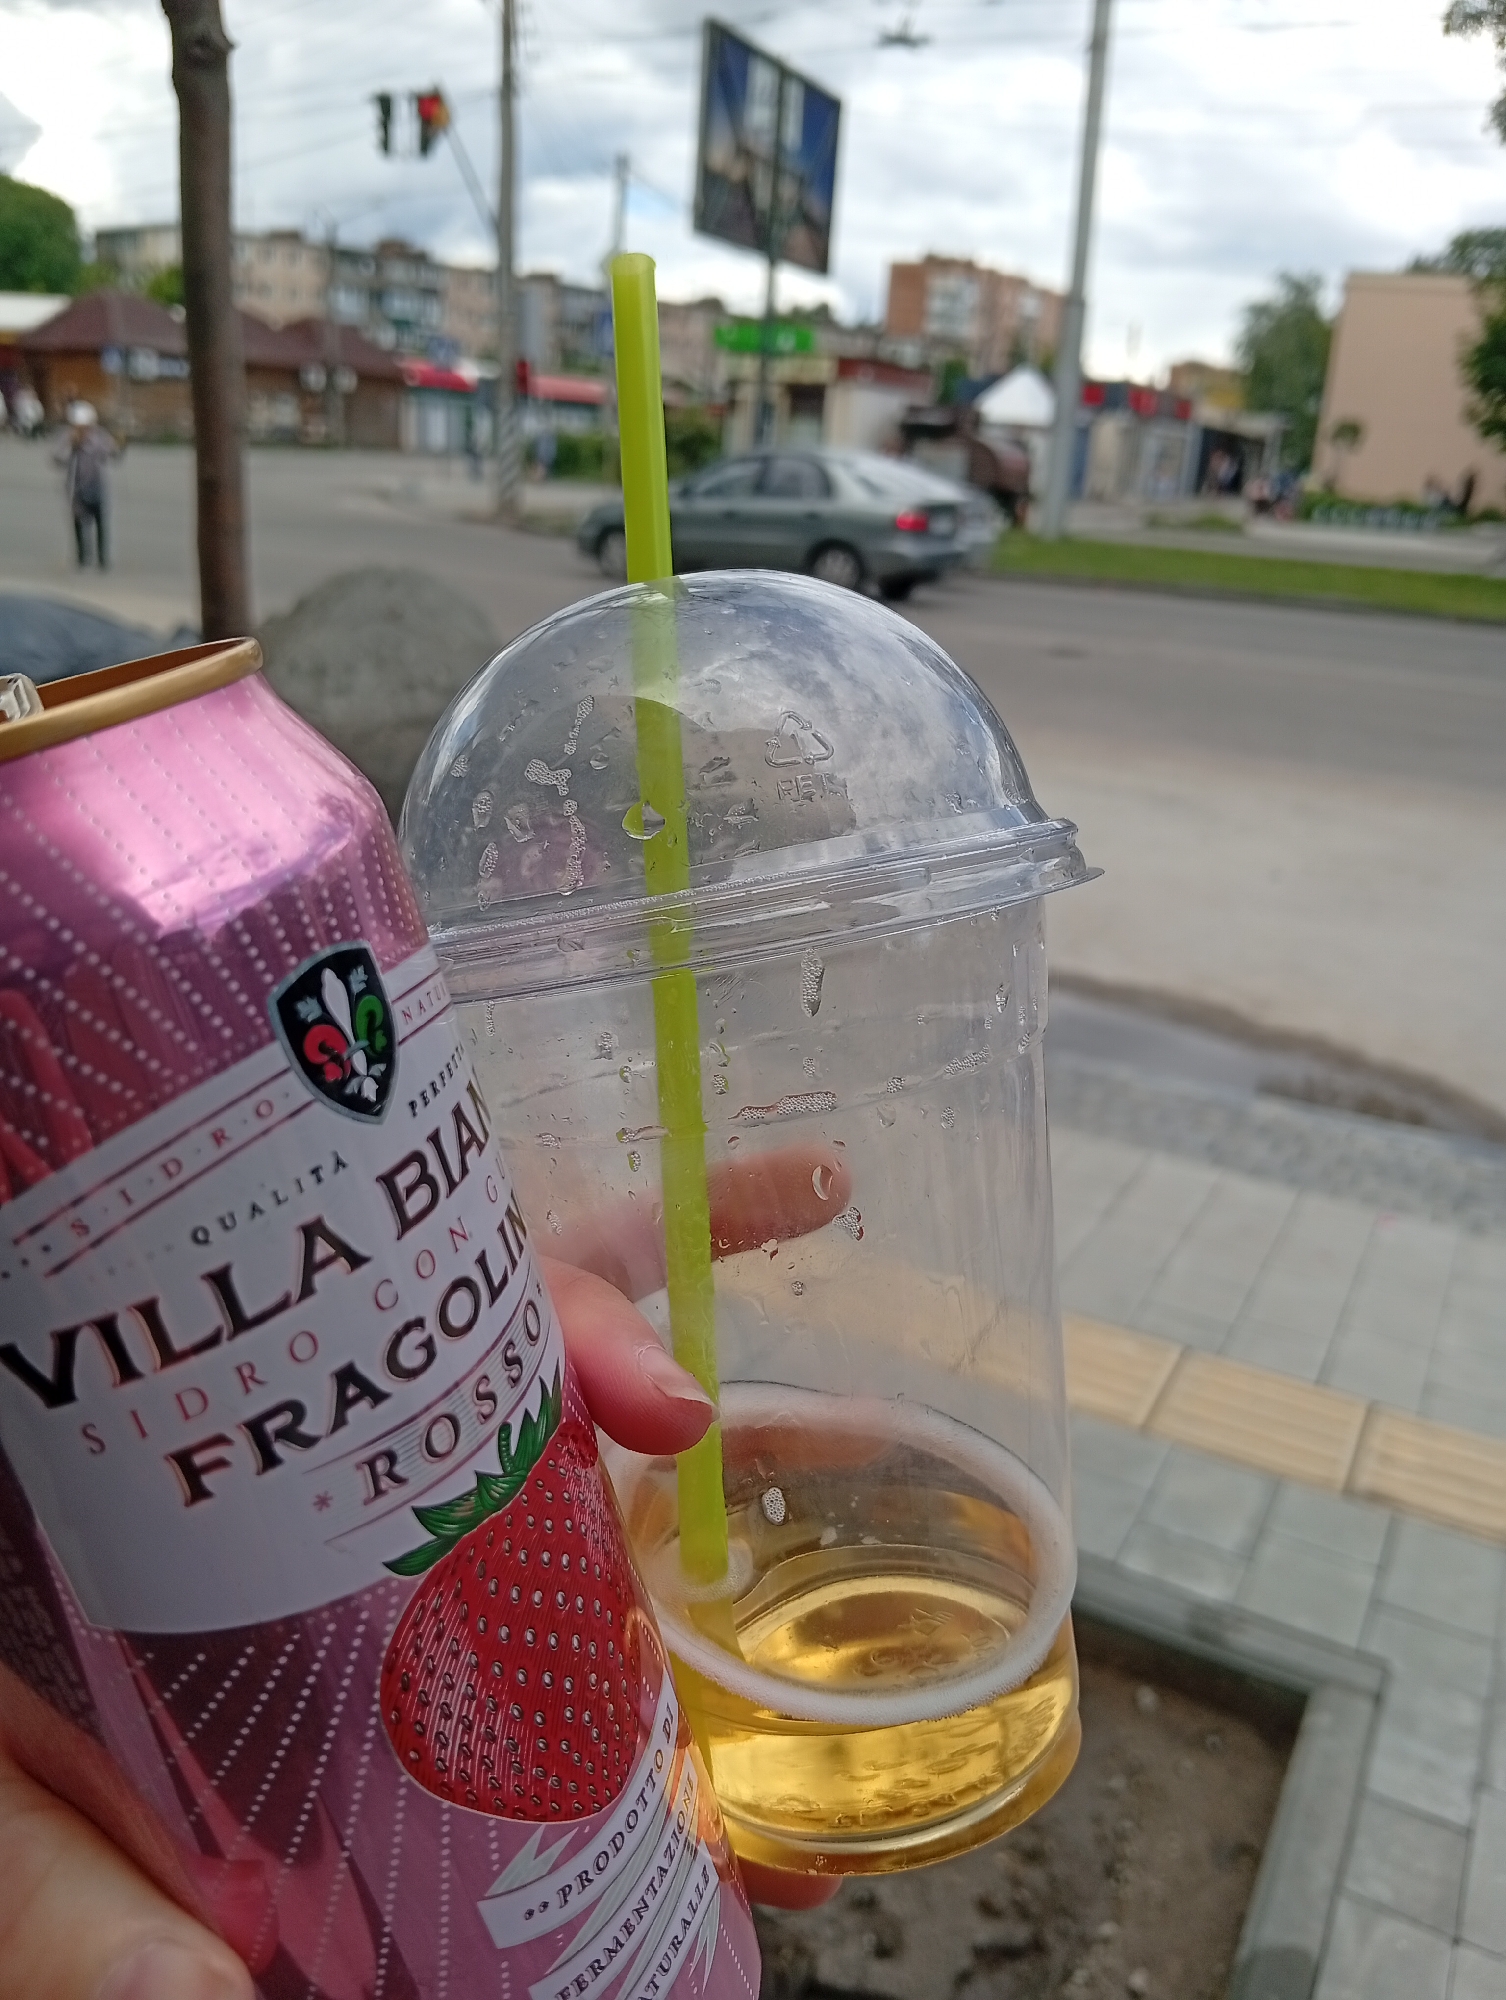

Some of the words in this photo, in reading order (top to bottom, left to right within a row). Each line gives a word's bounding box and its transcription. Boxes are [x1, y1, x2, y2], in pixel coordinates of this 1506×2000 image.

[0, 1214, 373, 1410] VILLA
[80, 1329, 320, 1457] SIDRO
[375, 1216, 471, 1312] CON
[354, 1299, 543, 1507] ROSSO
[556, 1748, 665, 1910] PRODOTTO
[661, 1702, 676, 1744] DI
